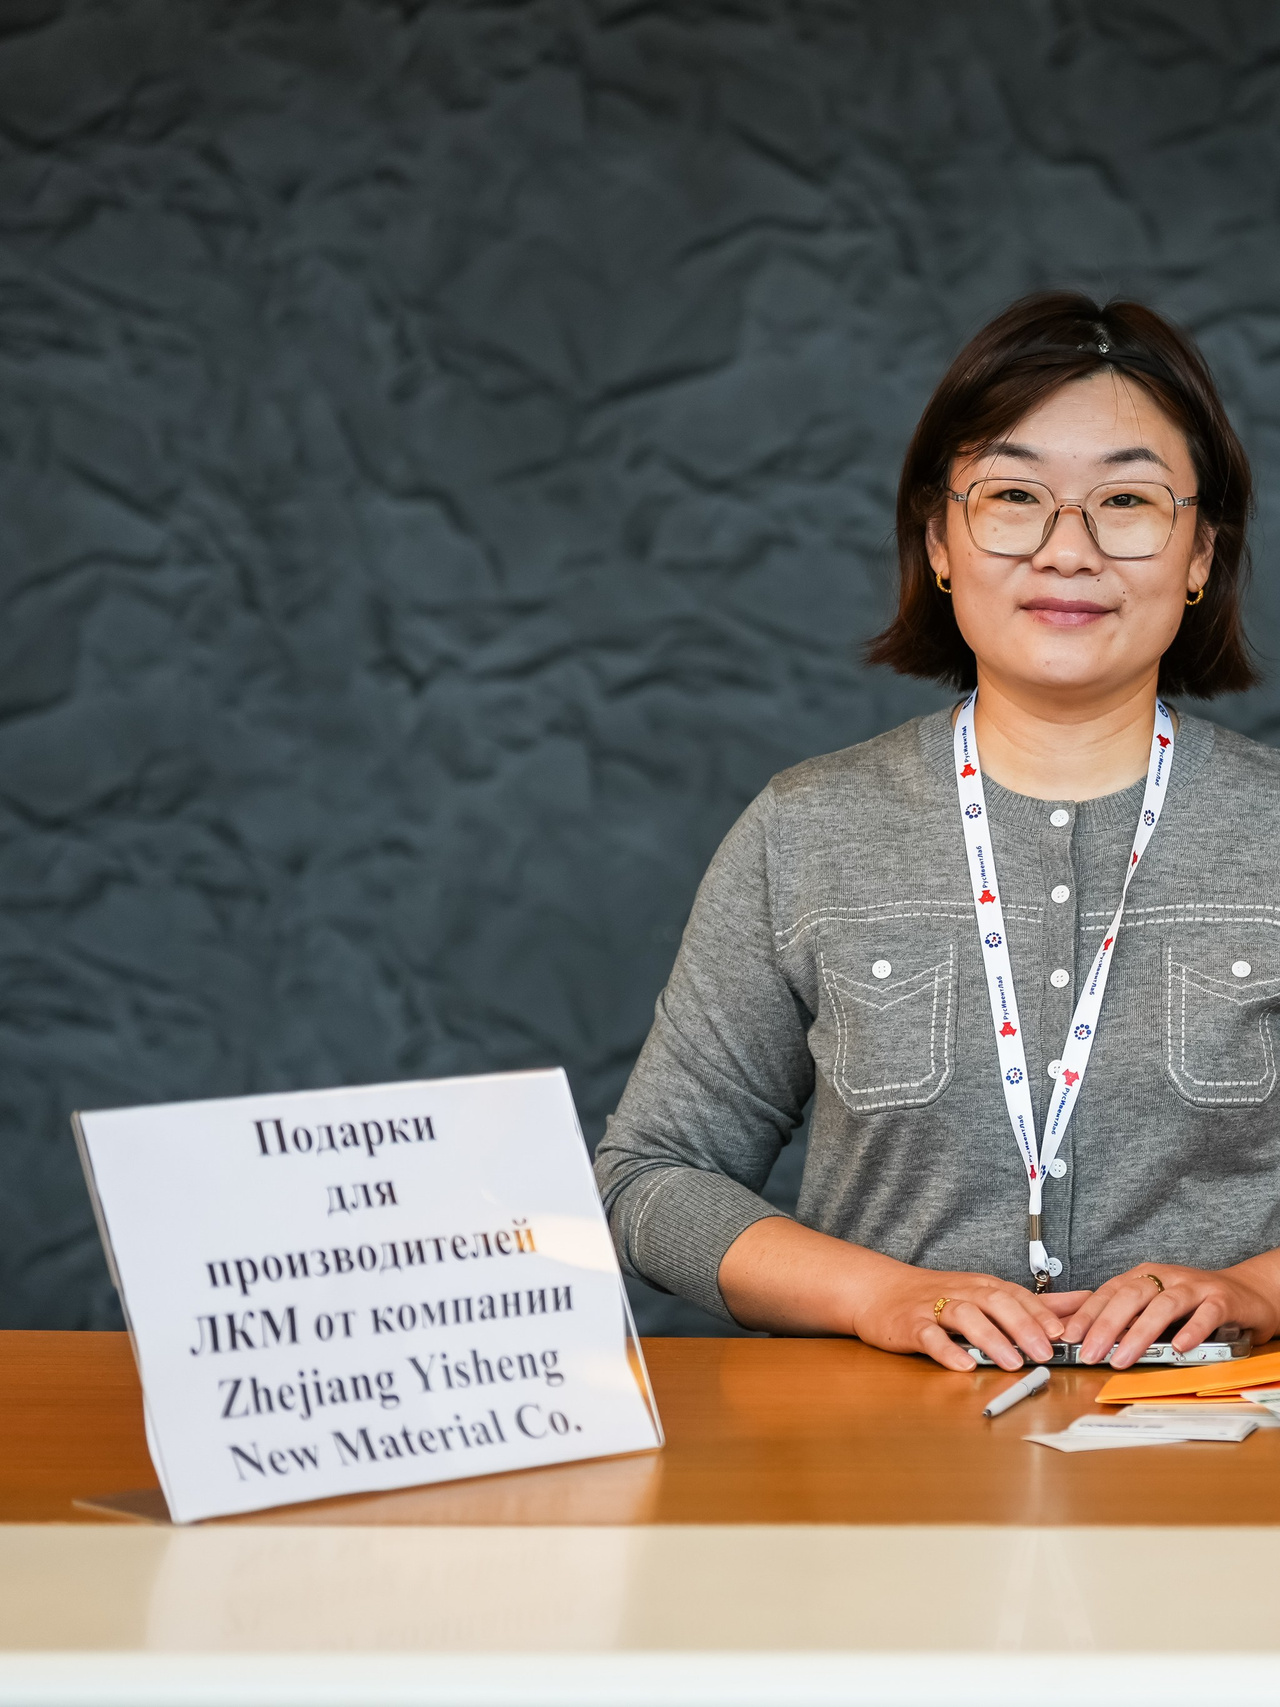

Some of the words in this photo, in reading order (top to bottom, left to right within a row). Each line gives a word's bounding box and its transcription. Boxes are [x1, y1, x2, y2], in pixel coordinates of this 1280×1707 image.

[975, 845, 989, 889] РусИвентЛаб
[996, 975, 1010, 1020] РусИвентЛаб
[1051, 1087, 1071, 1135] РусИвентЛаб
[253, 1116, 437, 1158] Подарки
[327, 1180, 399, 1217] для
[205, 1218, 538, 1296] производителей
[189, 1306, 302, 1357] ЛКМ
[314, 1311, 357, 1342] от
[371, 1284, 574, 1335] компании
[218, 1368, 400, 1419] Zhejiang
[407, 1348, 565, 1392] Yisheng
[229, 1444, 322, 1482] New
[331, 1410, 508, 1467] Material
[514, 1402, 583, 1440] Co.
